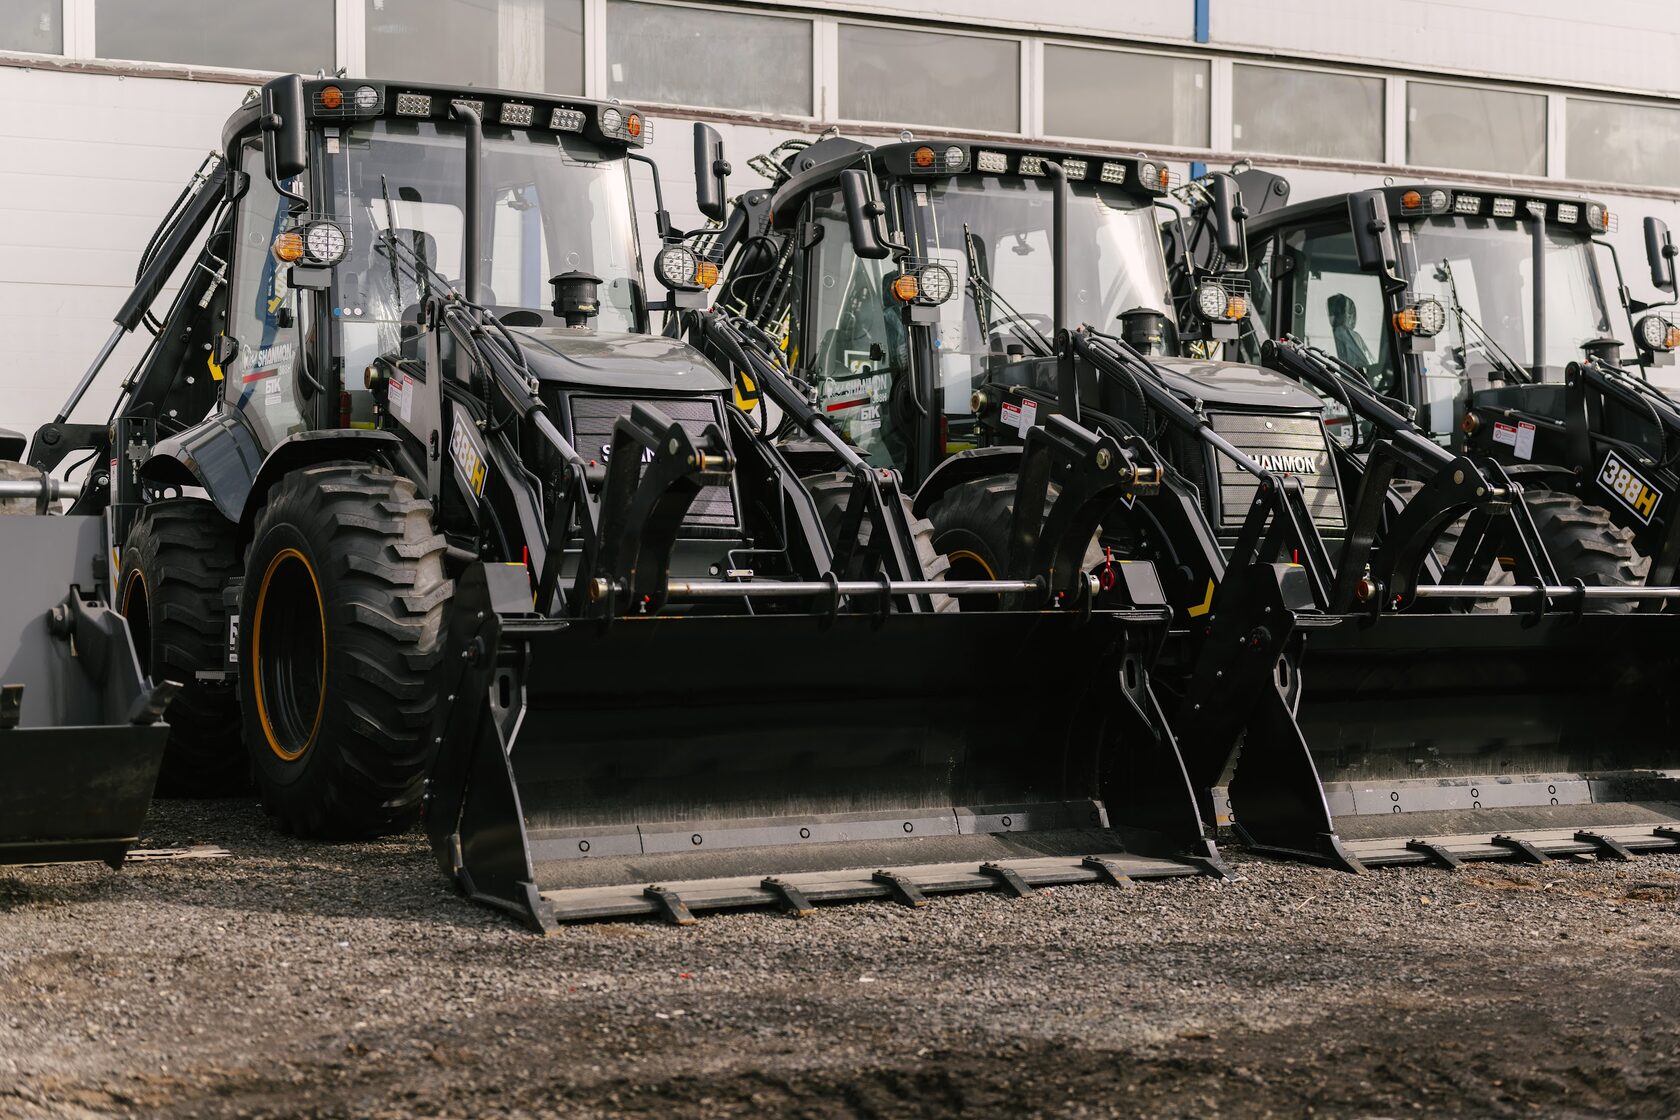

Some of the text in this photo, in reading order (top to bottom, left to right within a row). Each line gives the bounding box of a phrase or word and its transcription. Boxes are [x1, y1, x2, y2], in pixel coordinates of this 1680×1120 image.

[452, 421, 485, 497] 388H
[1237, 454, 1315, 473] HANMON
[1602, 458, 1657, 517] 388H
